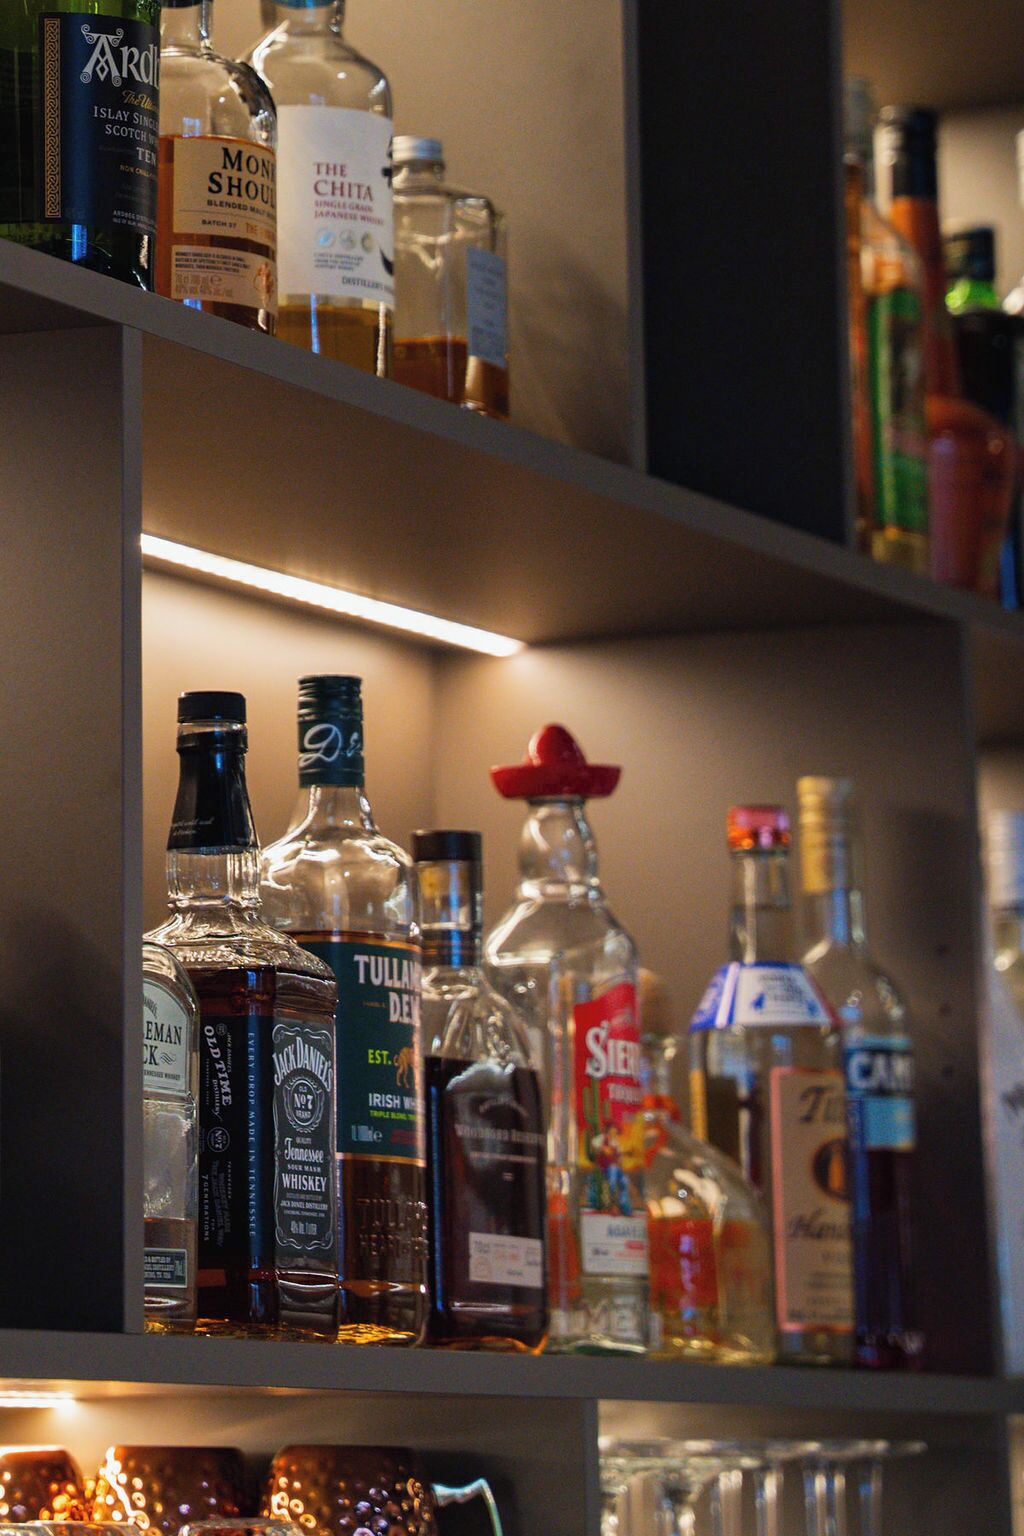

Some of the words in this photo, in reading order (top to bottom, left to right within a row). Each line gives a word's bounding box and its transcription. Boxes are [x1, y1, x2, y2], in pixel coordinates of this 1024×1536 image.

[94, 105, 130, 123] ISLAY
[133, 112, 159, 132] SINGL
[105, 124, 147, 143] SCOTCH
[136, 146, 157, 167] TEN
[313, 163, 347, 178] THE
[313, 179, 374, 202] CHITA
[206, 199, 248, 212] BLENDED
[314, 199, 348, 212] SINGLE
[201, 218, 227, 228] BATCH
[314, 210, 357, 223] JAPANESE
[247, 1032, 256, 1069] EVERY
[367, 1048, 392, 1065] EST.
[204, 1025, 221, 1059] OLD
[215, 1060, 232, 1106] TIME
[272, 1044, 297, 1086] JACK
[296, 1036, 334, 1092] DANIEL'S
[247, 1075, 256, 1105] DROP
[368, 1092, 401, 1109] IRISH
[247, 1110, 256, 1144] MADE
[247, 1149, 256, 1162] IN
[284, 1136, 325, 1164] Tennessee
[281, 1172, 327, 1193] WHISKEY
[247, 1168, 257, 1238] TENNESSEE
